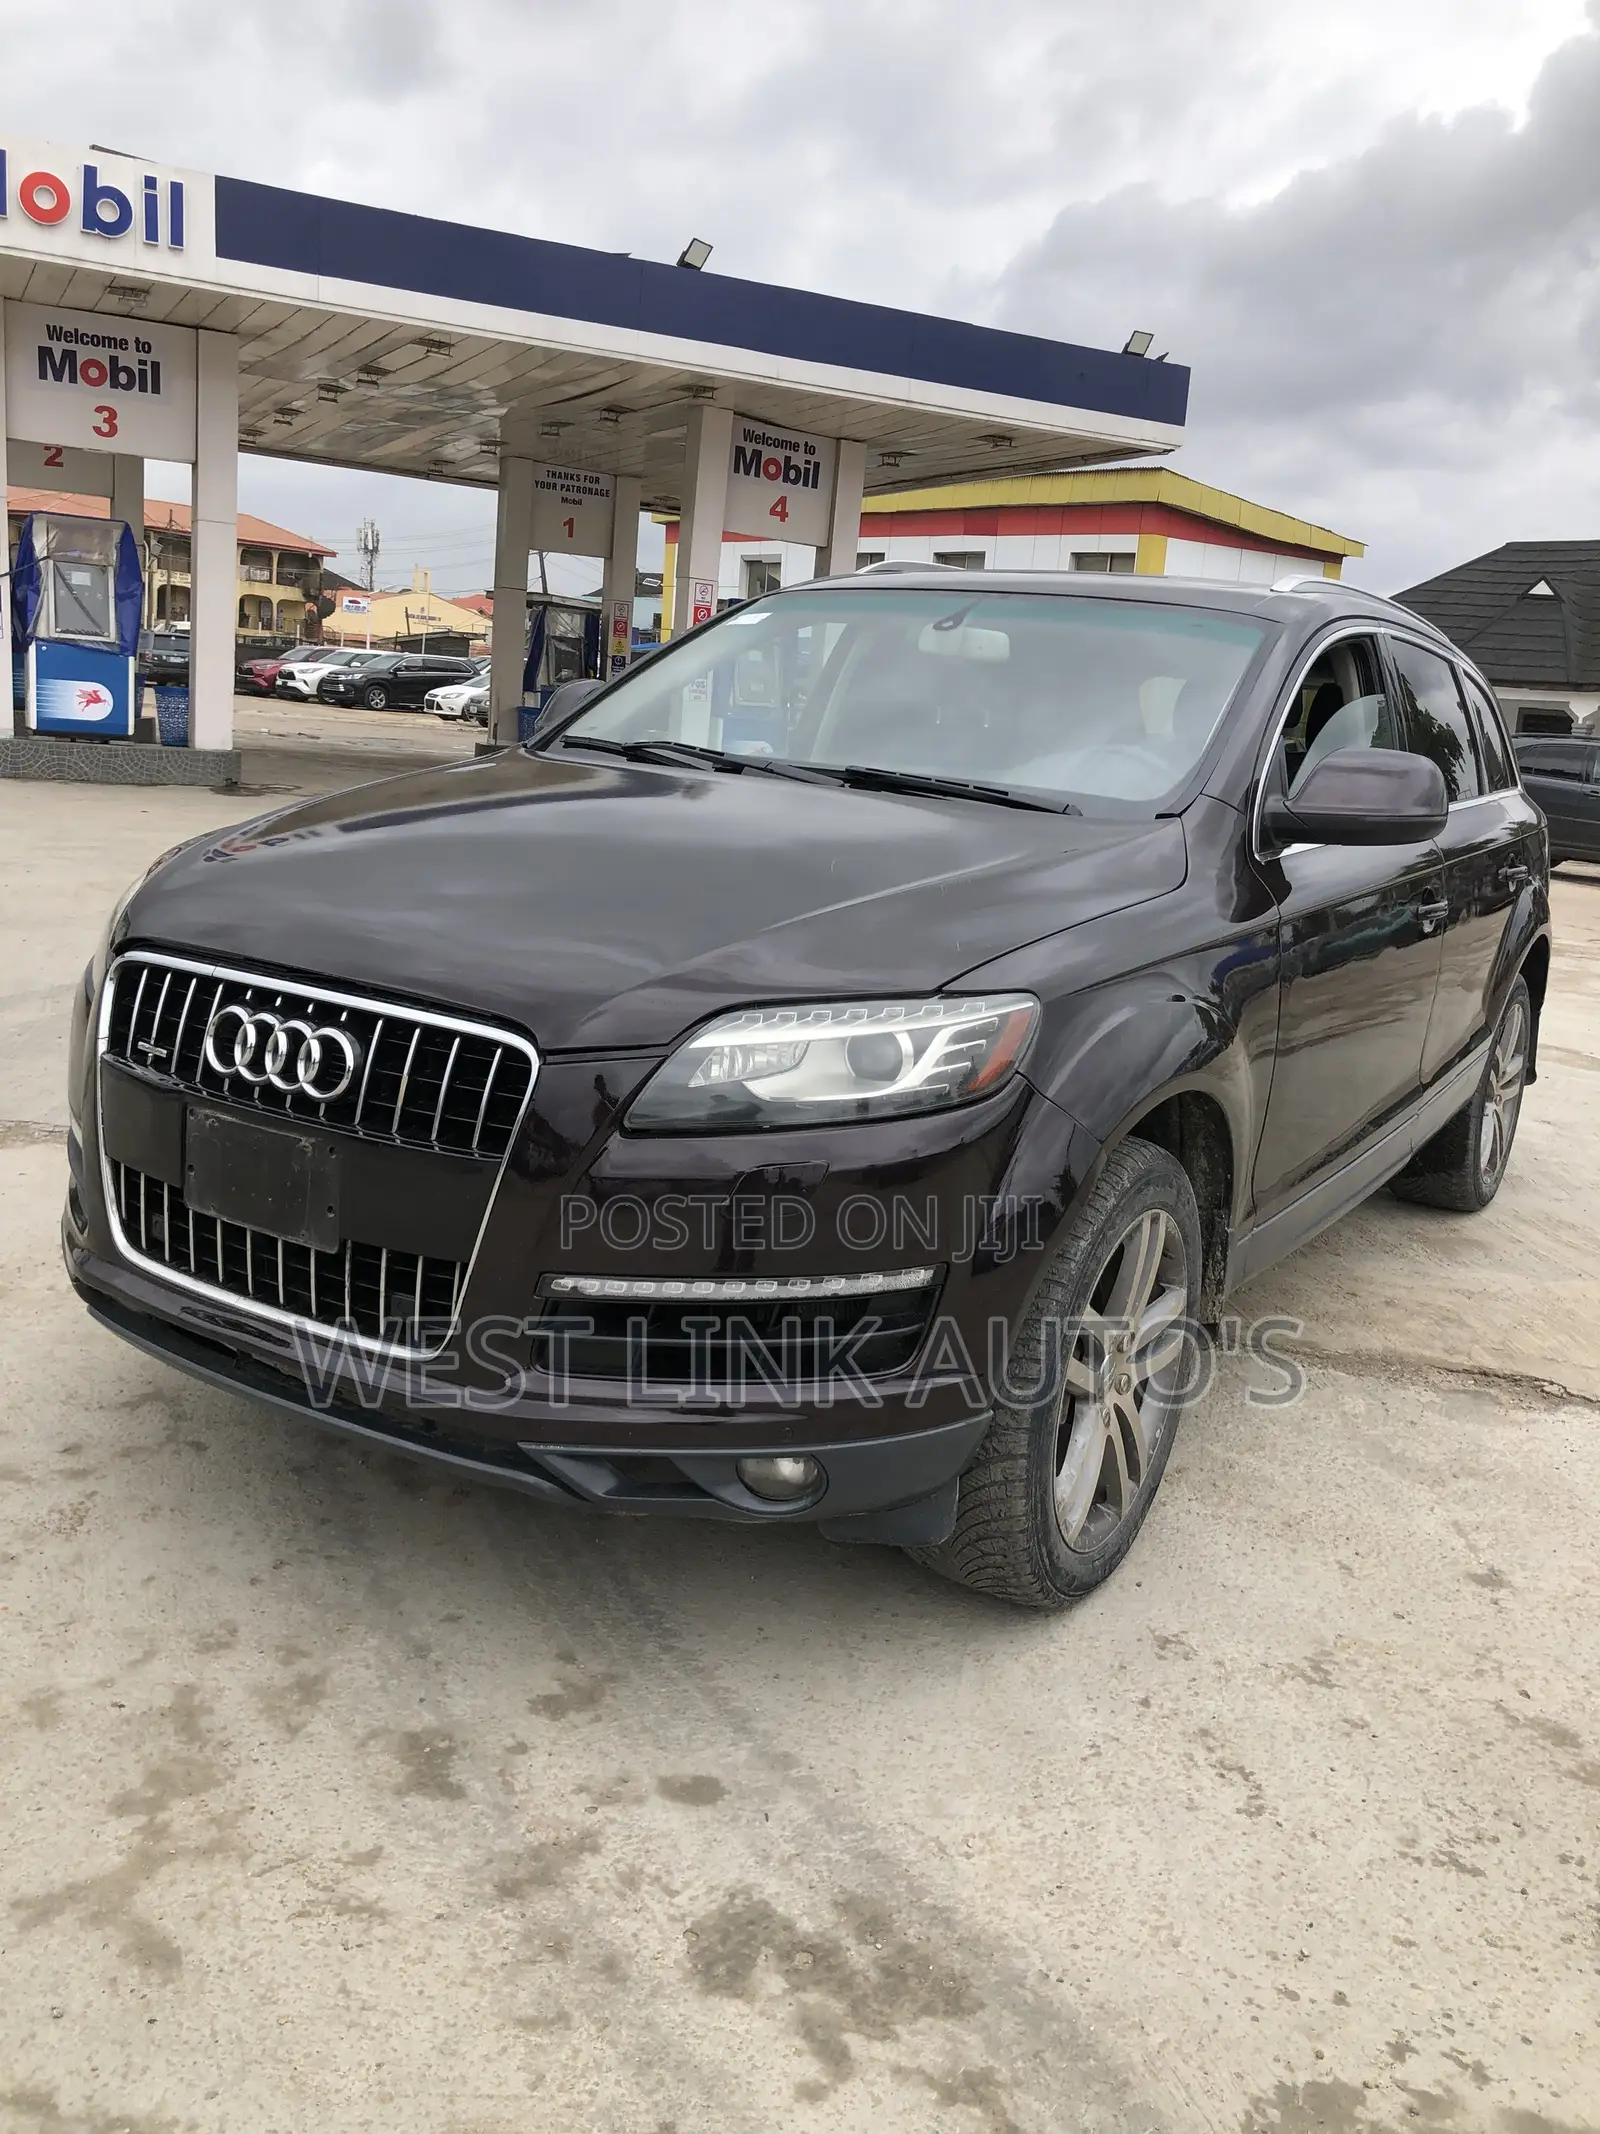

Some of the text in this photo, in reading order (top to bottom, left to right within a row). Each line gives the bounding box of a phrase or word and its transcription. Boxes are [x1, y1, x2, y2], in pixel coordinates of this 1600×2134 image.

[0, 149, 184, 249] obil
[46, 324, 152, 354] Welcome to
[38, 345, 161, 395] Mobil
[92, 405, 119, 438] 3
[743, 428, 816, 455] Welcome to
[43, 445, 64, 467] 2
[734, 445, 820, 489] Mobil
[535, 480, 610, 497] YOUR PATRONAGE
[546, 469, 600, 484] THANKS FOR
[561, 496, 582, 505] Mobil
[769, 495, 789, 522] 4
[563, 517, 575, 538] 1
